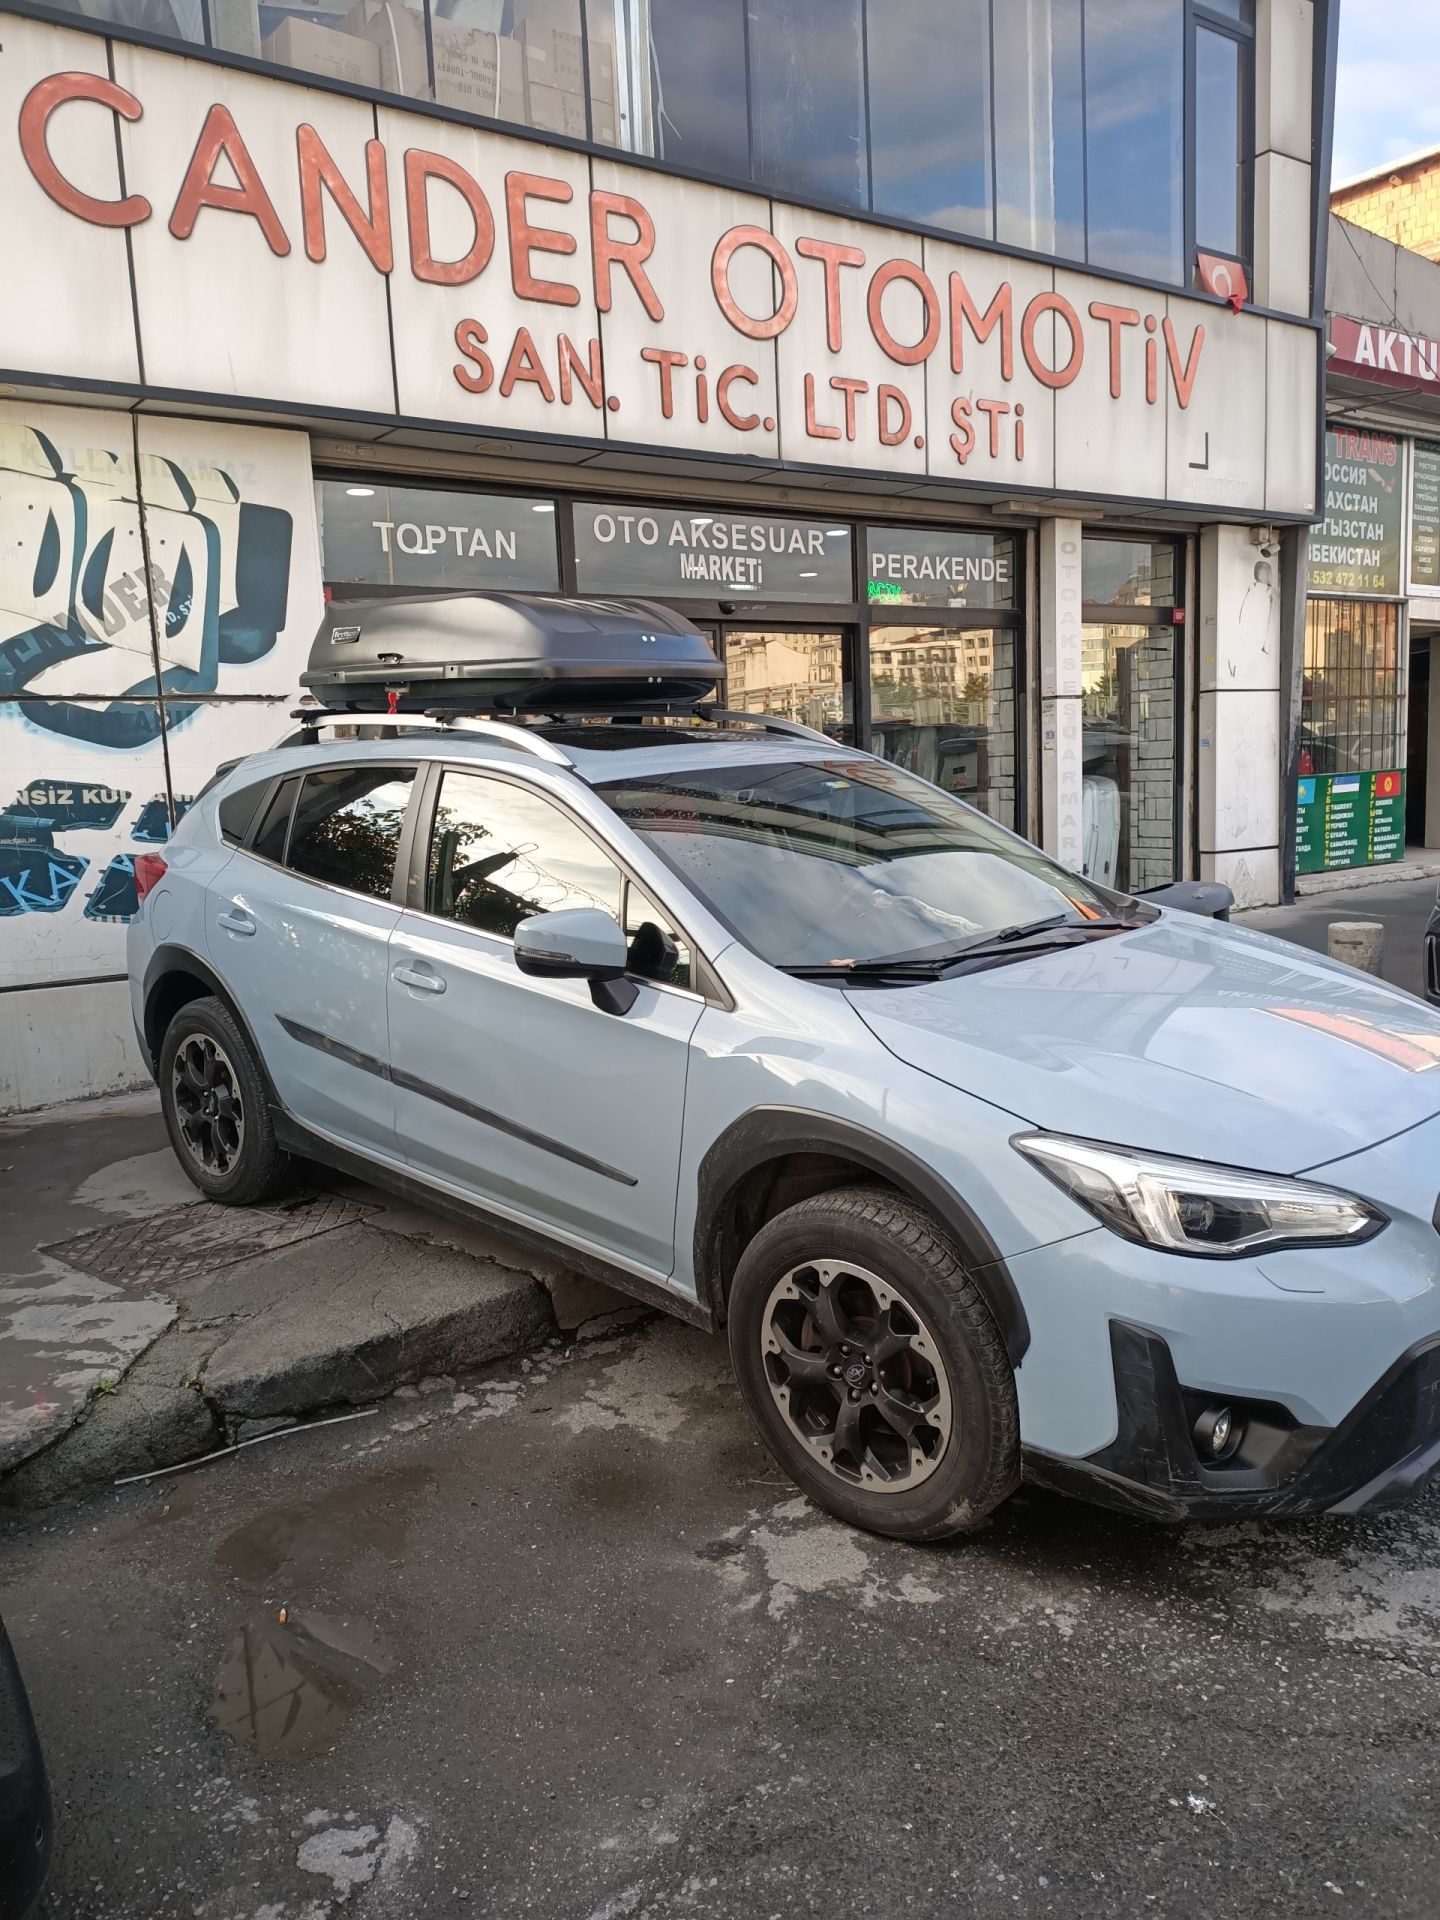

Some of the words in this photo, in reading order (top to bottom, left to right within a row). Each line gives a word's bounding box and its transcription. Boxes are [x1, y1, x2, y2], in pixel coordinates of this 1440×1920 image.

[18, 70, 664, 322] CANDER
[453, 318, 621, 412] SAN.
[804, 371, 925, 450] LTD.
[1333, 425, 1397, 467] TRANS
[1325, 490, 1378, 514] АХСТАН
[372, 520, 517, 560] TOPTAN
[592, 514, 660, 546] OTO
[668, 519, 826, 556] AKSESUAR
[871, 552, 1009, 584] PERAKENDE
[1312, 570, 1333, 585] 532
[1335, 572, 1355, 587] 472
[1372, 574, 1385, 589] 64
